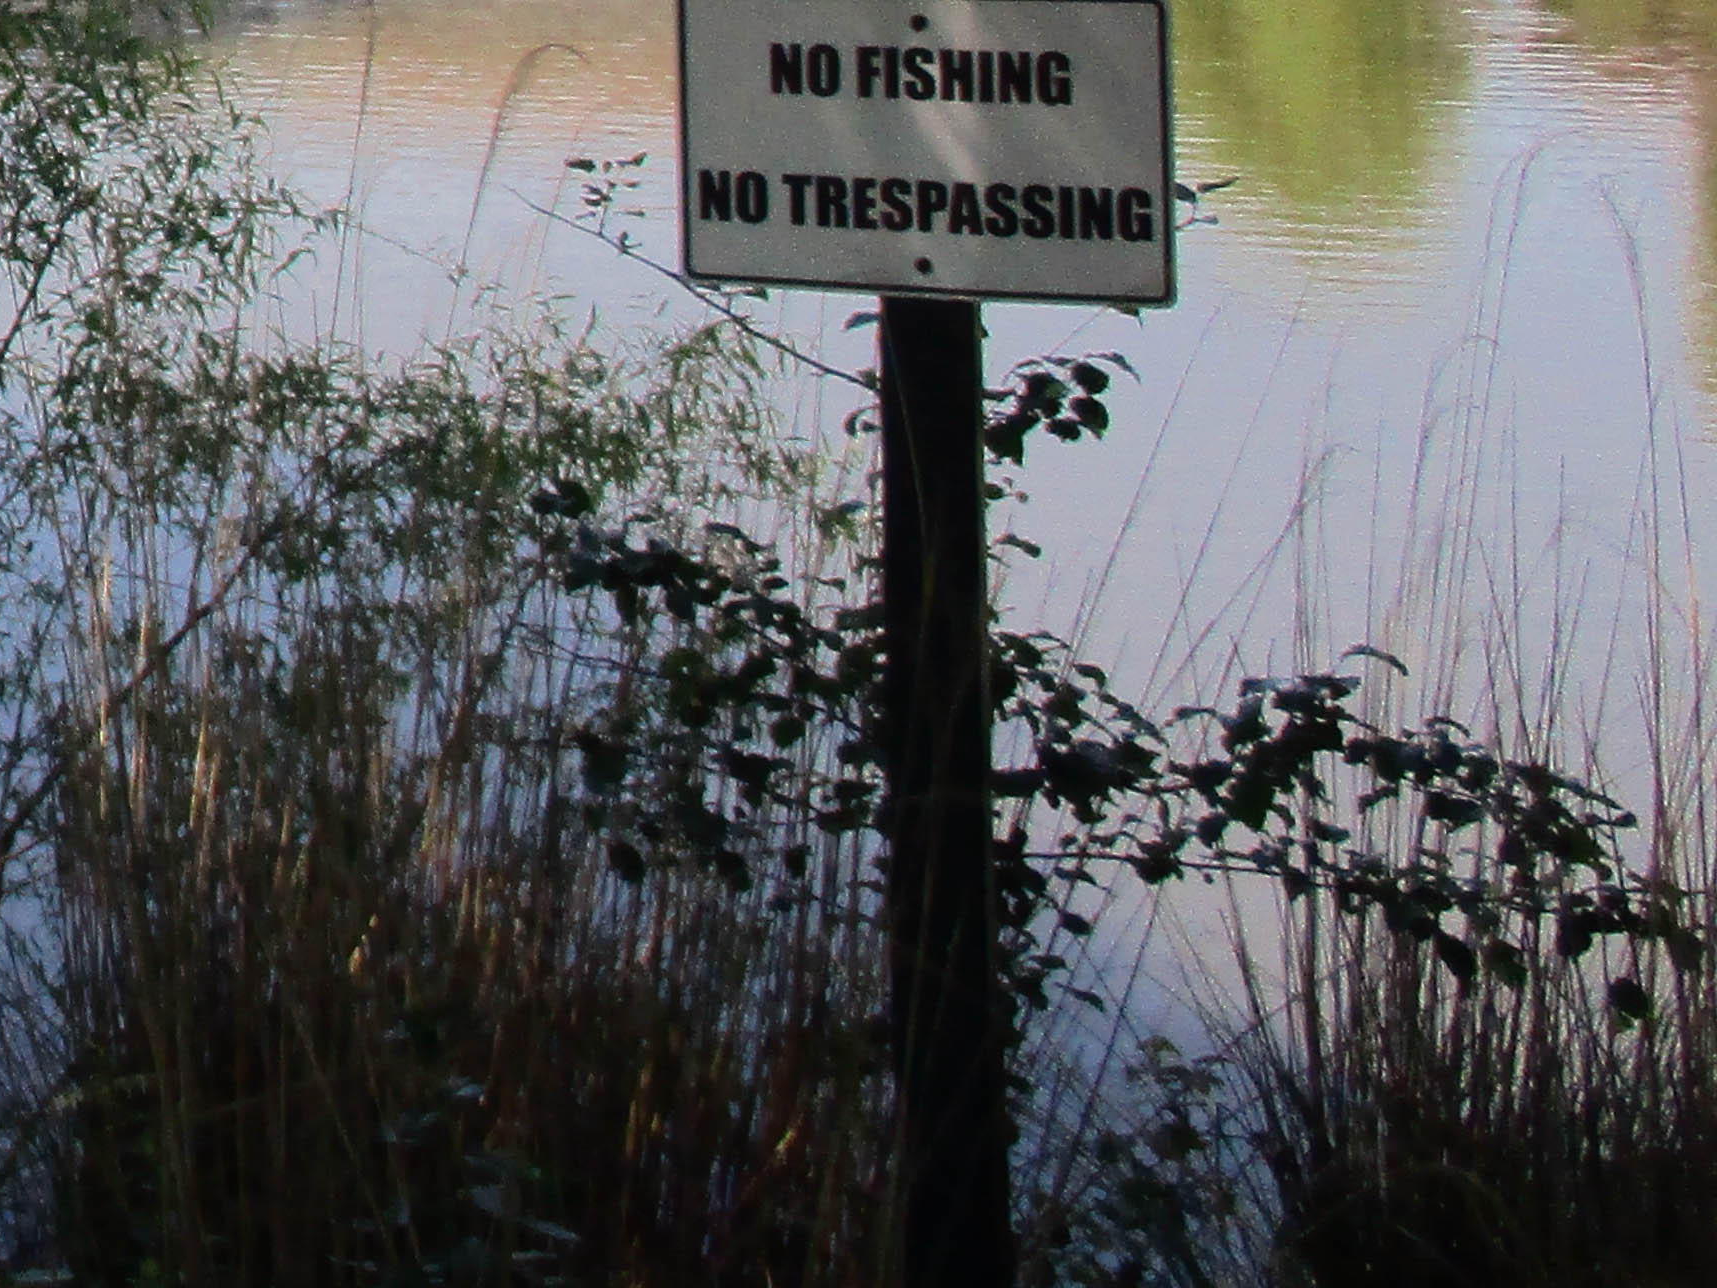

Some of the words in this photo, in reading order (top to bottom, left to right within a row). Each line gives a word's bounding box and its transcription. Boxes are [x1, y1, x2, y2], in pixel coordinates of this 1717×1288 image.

[769, 42, 841, 98] NO
[855, 44, 1075, 107] FISHING
[697, 168, 770, 225] NO
[781, 173, 1157, 243] TRESPASSING
